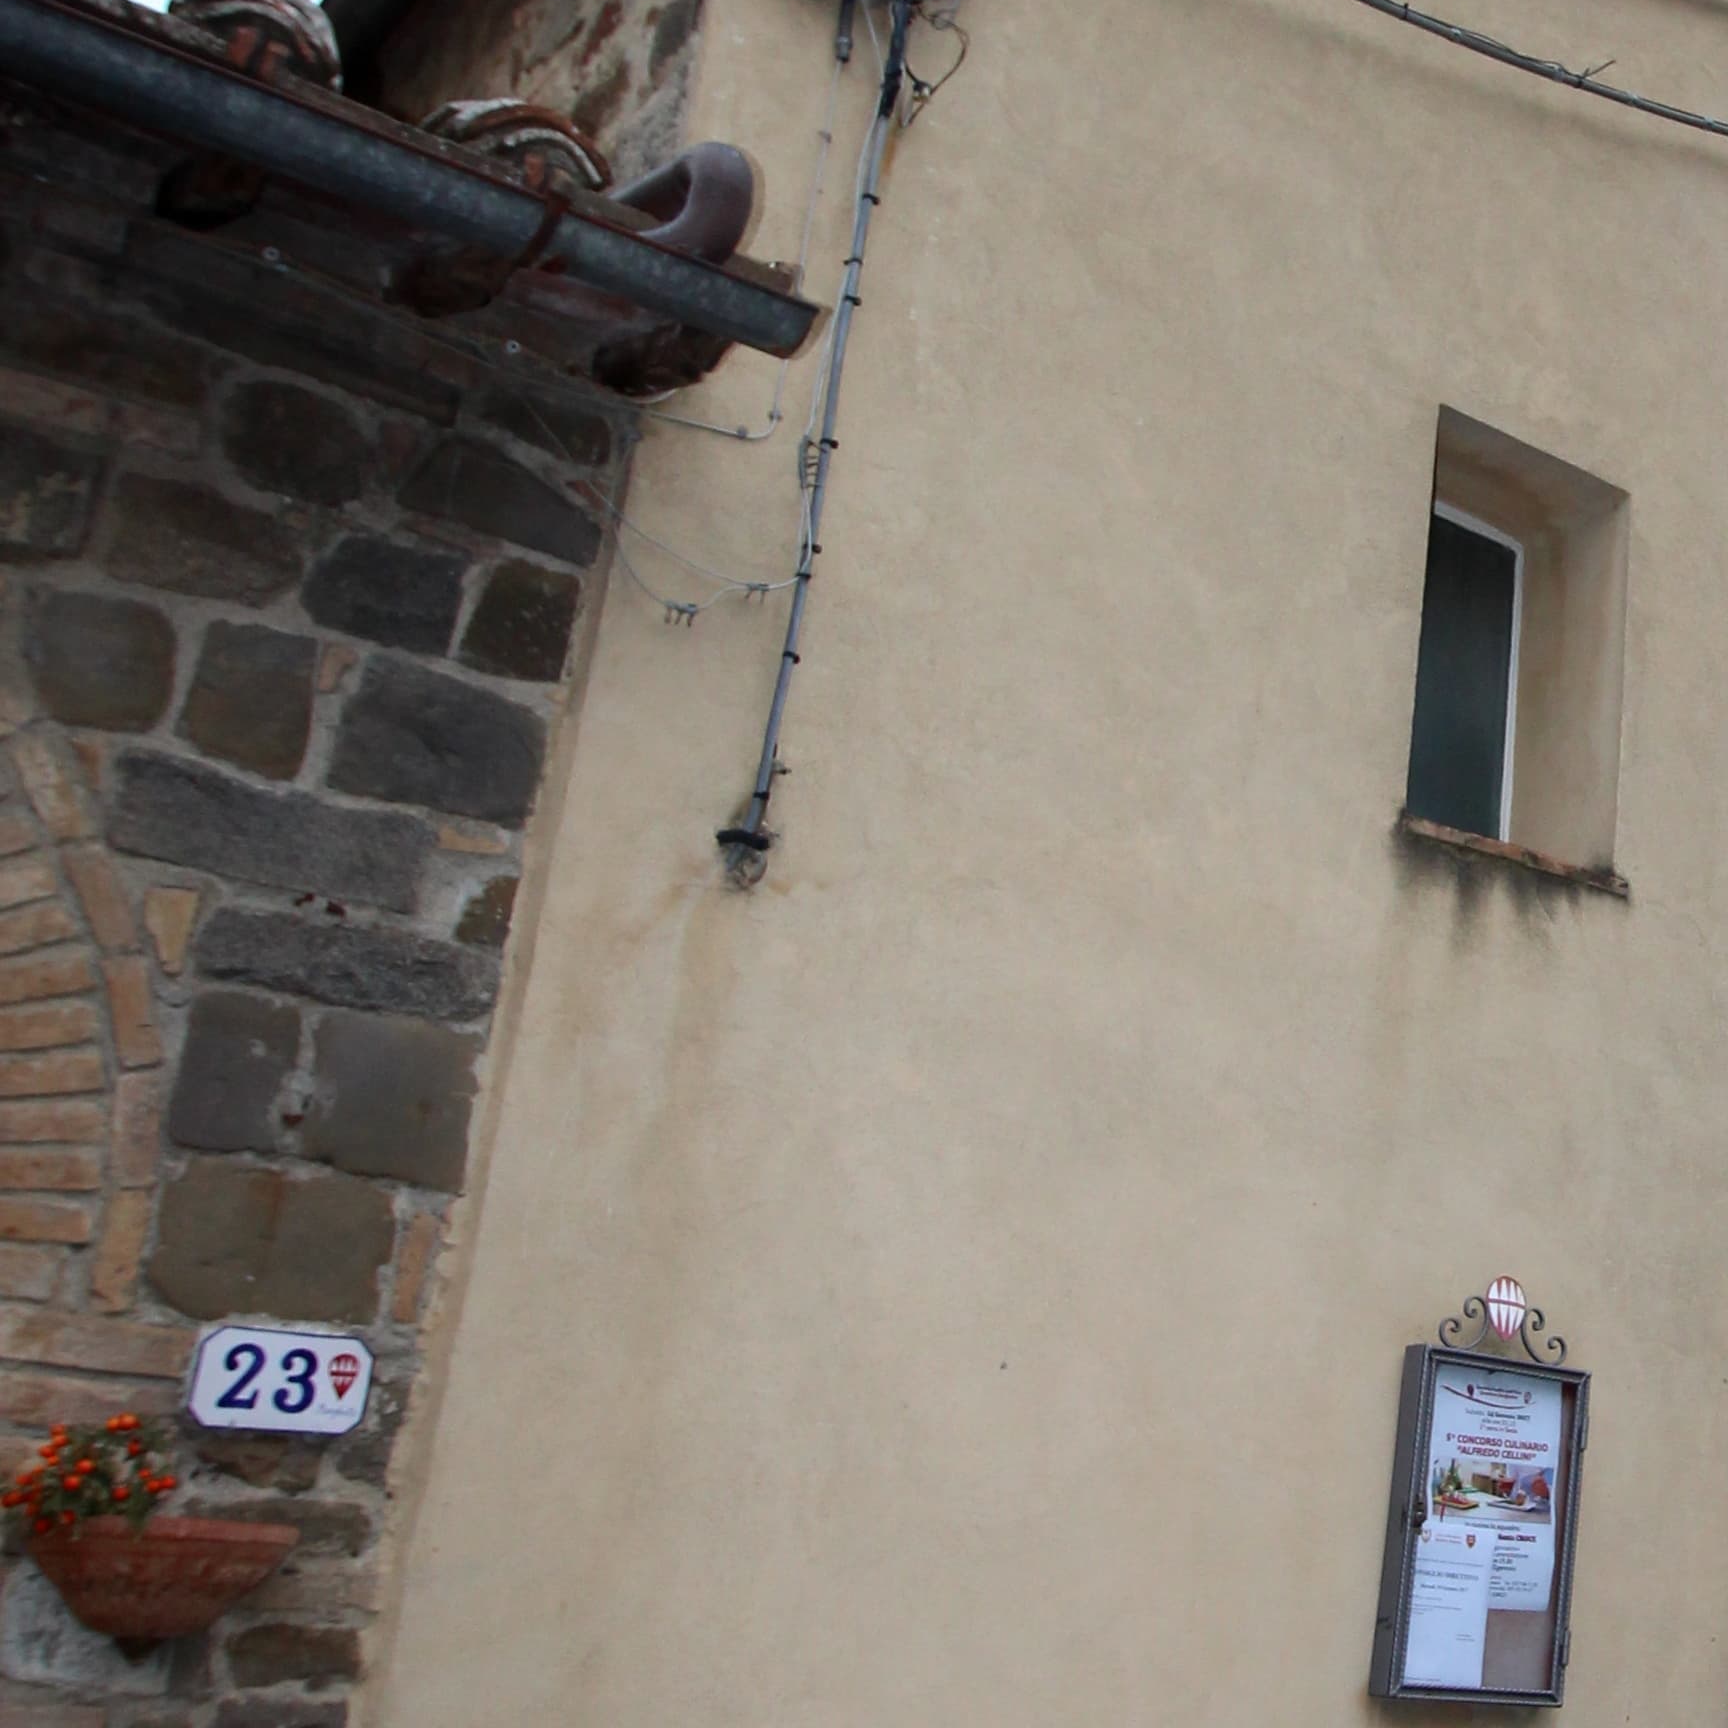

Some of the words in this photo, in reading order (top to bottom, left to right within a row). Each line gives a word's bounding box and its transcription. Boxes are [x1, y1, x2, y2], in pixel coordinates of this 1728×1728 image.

[216, 1343, 319, 1413] 23
[1457, 1434, 1502, 1447] CONCORSO
[1504, 1439, 1549, 1452] CULINARIO
[1457, 1446, 1499, 1458] "ALFREDO
[1501, 1450, 1537, 1461] CELLINI"
